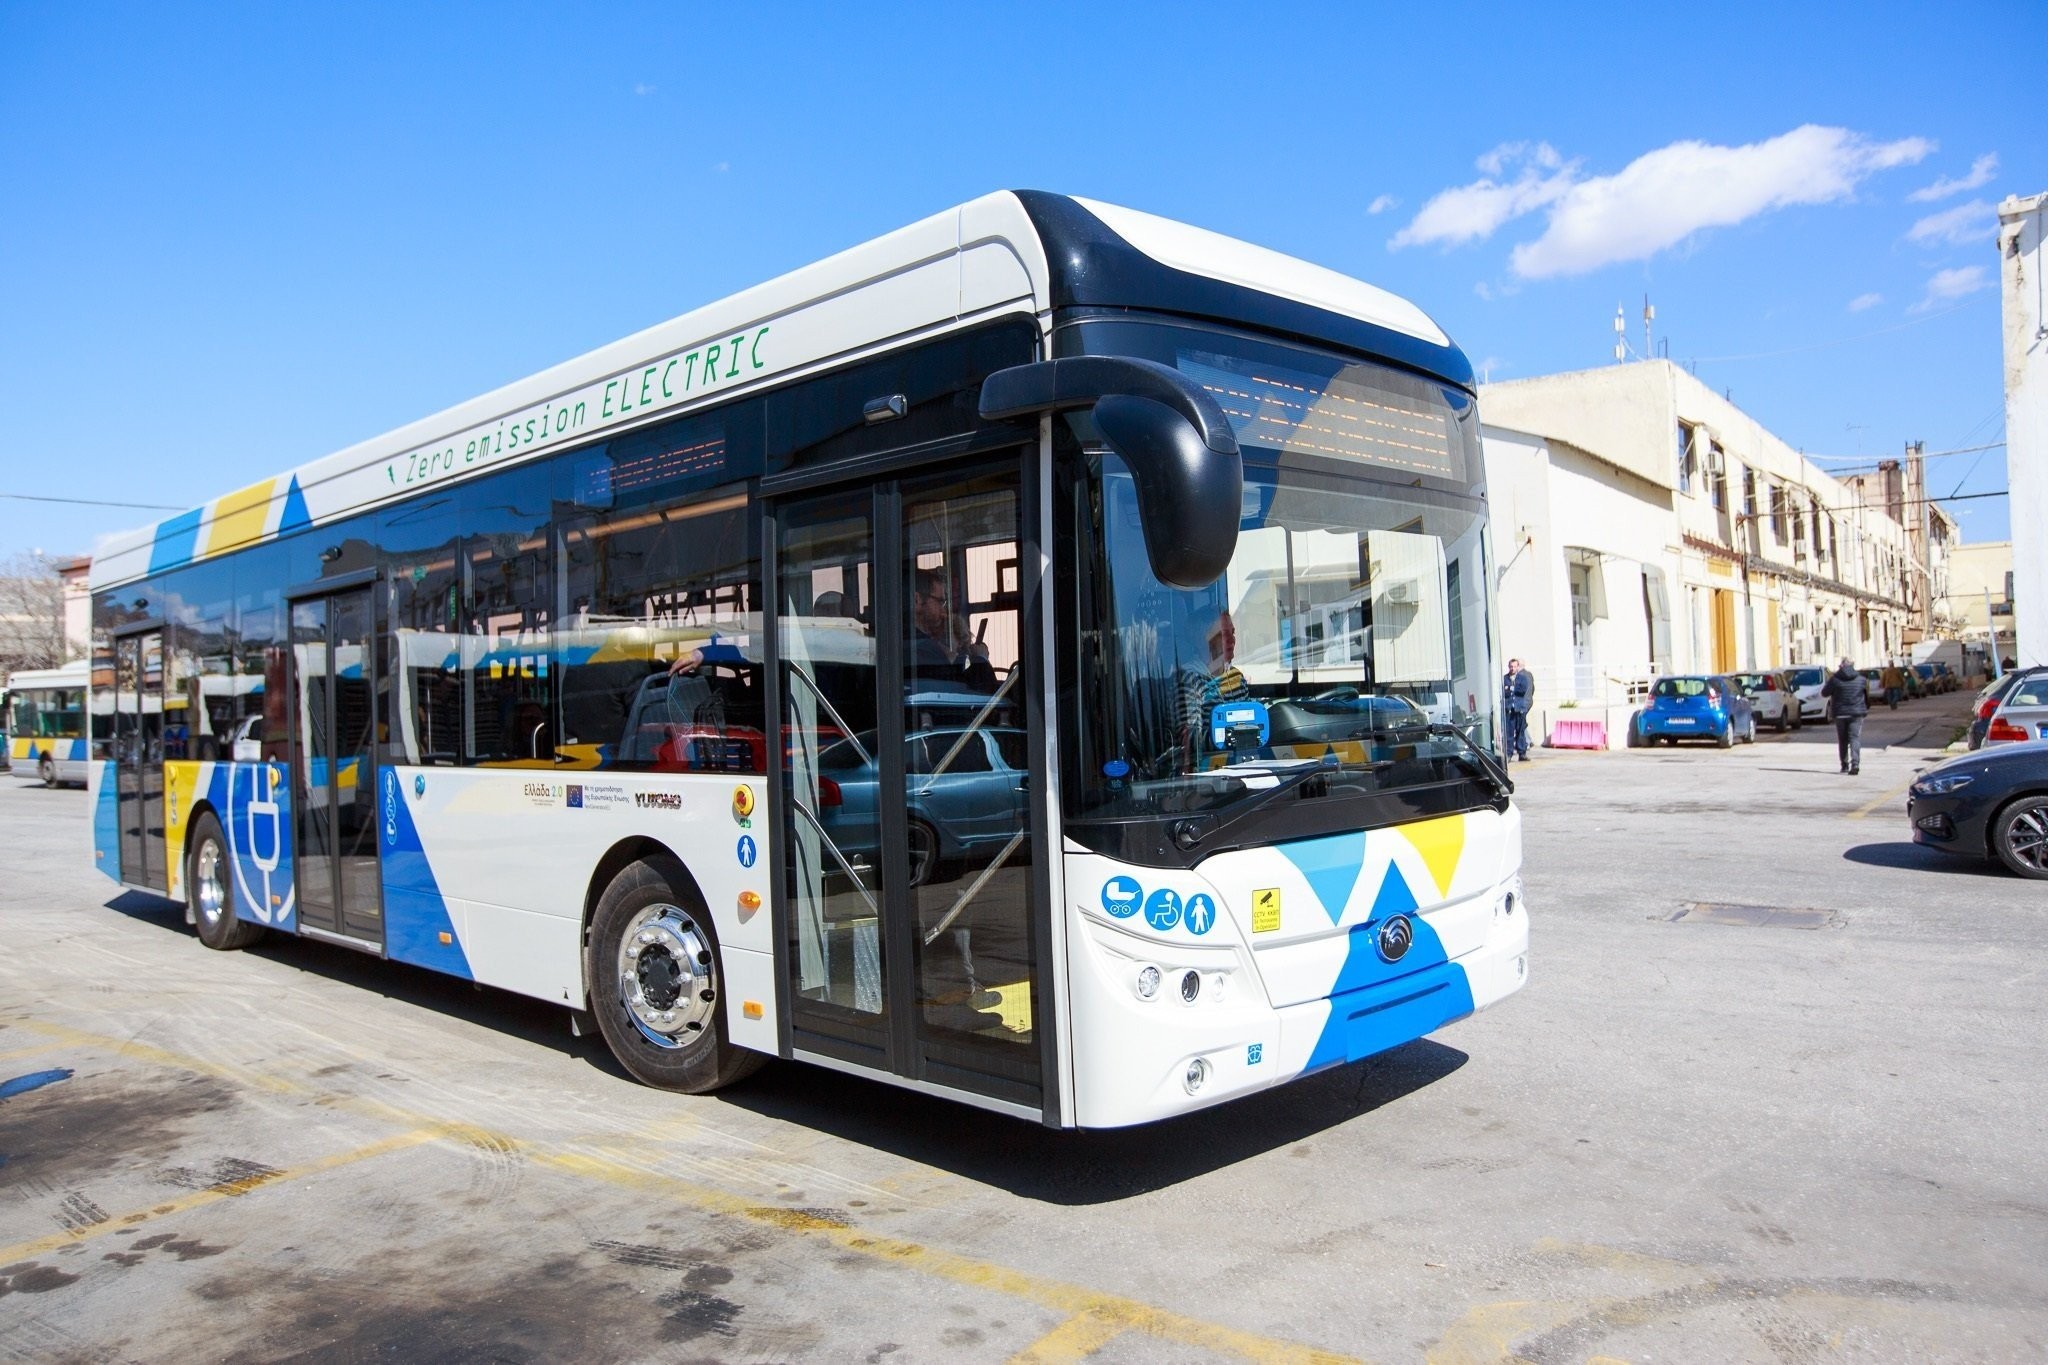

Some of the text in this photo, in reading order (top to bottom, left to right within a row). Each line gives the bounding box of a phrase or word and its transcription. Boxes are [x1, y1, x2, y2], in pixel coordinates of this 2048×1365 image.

[406, 327, 770, 484] Zero emission ELECTRIC
[524, 783, 550, 796] Ελλάδα
